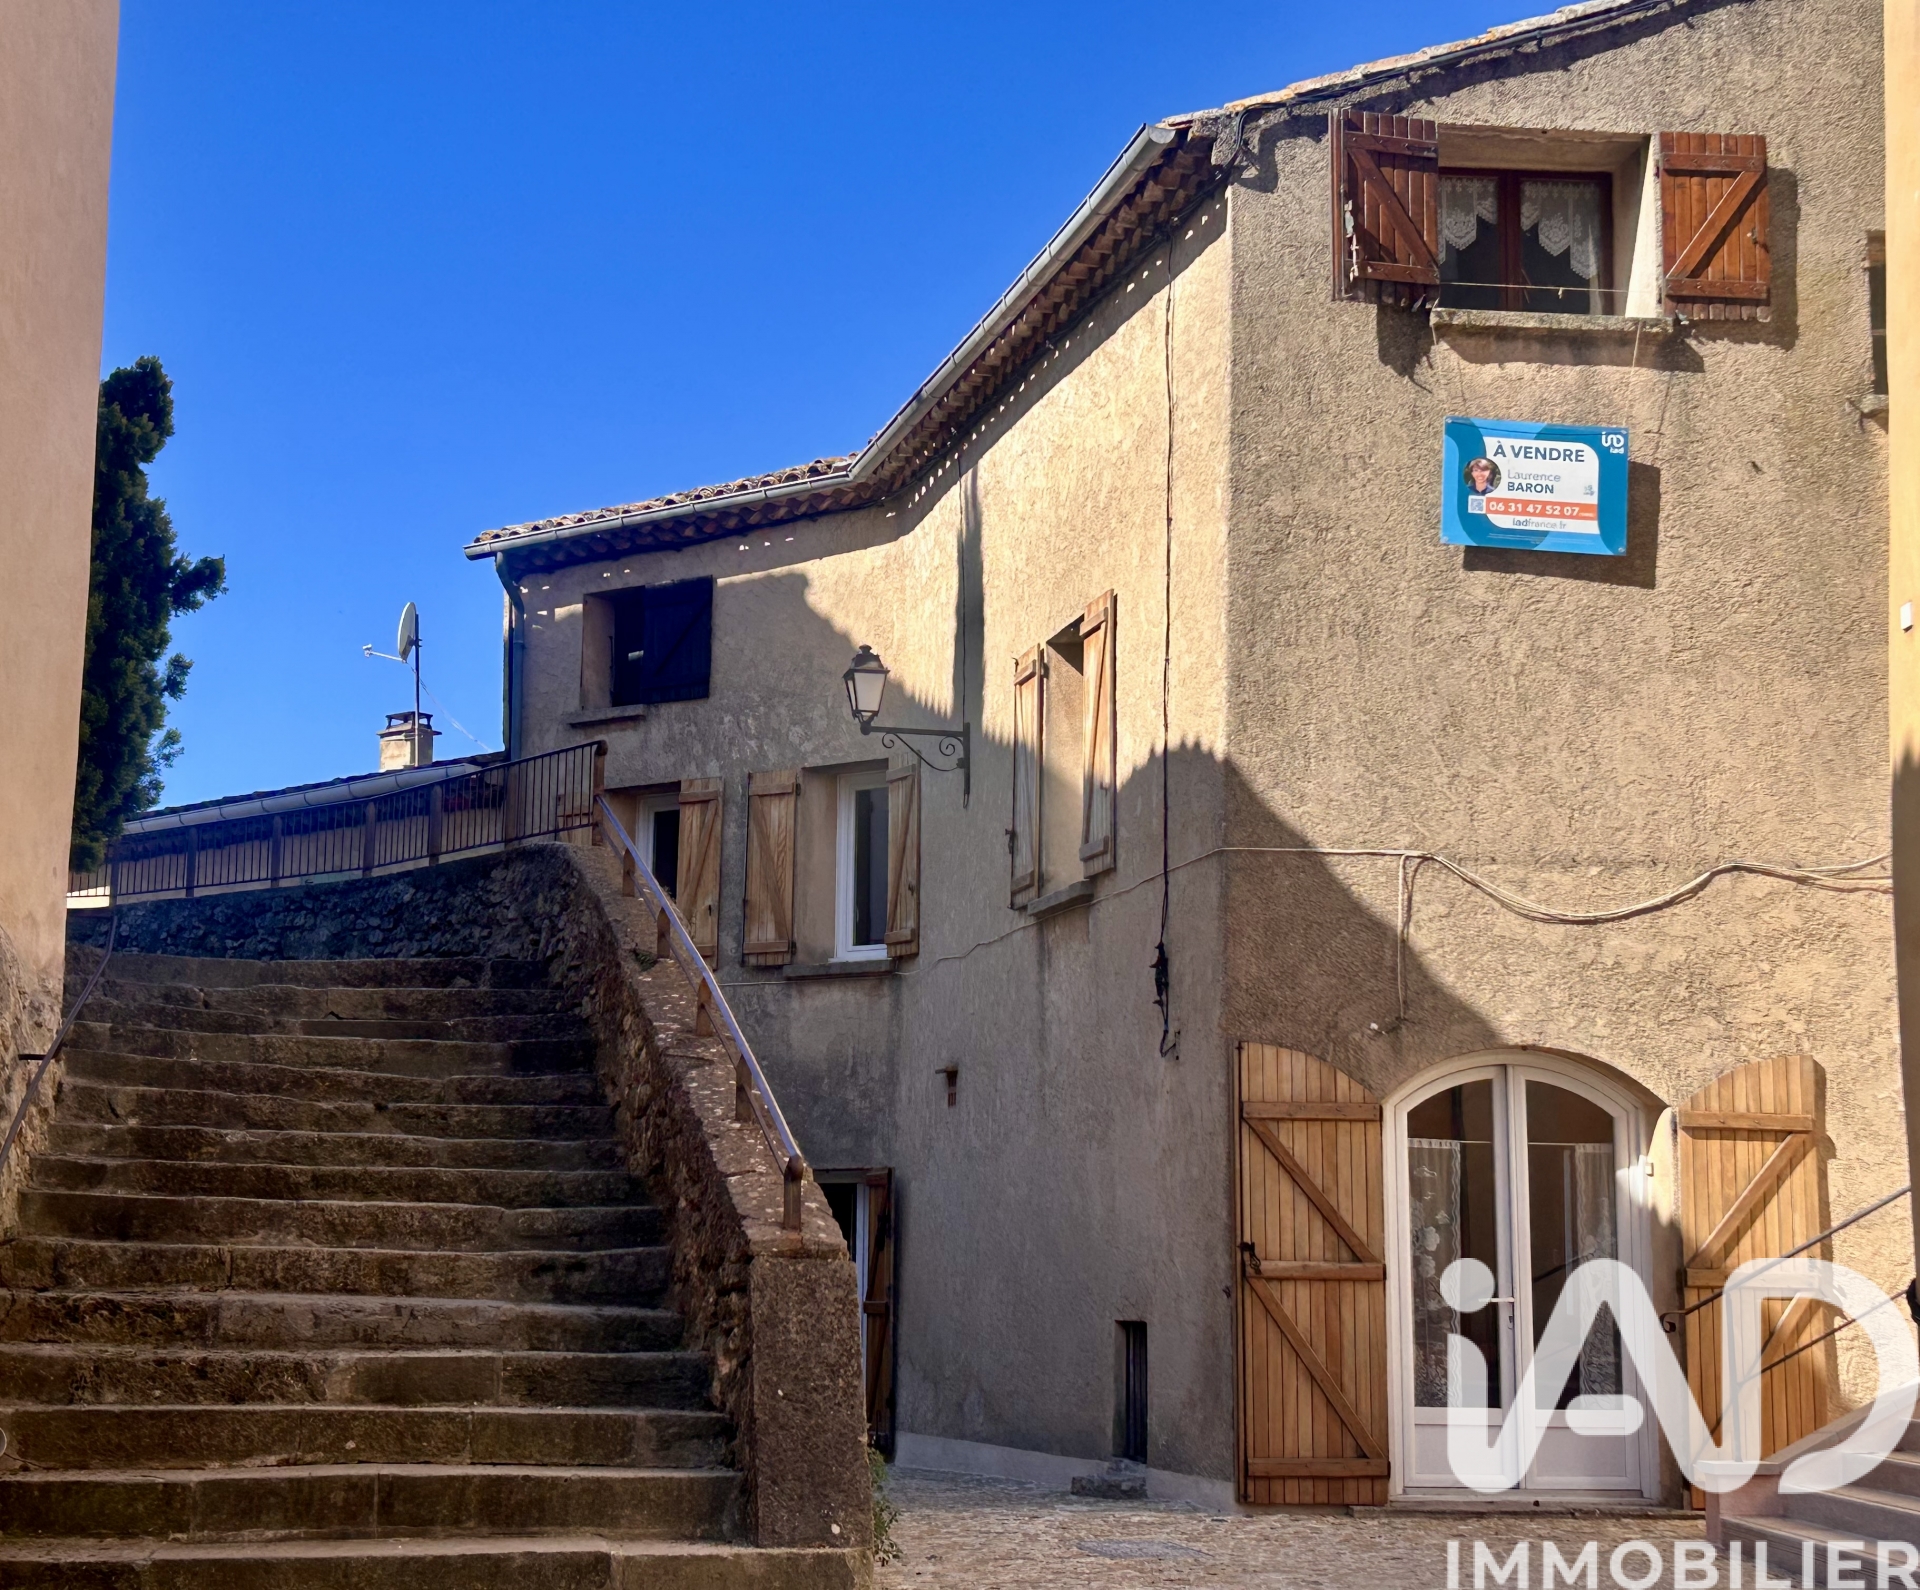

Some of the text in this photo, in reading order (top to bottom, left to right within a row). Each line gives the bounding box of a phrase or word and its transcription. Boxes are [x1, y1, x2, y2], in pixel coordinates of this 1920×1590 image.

[1493, 440, 1585, 463] À VENDRE
[1507, 469, 1561, 482] Laurence
[1507, 482, 1554, 494] BARON
[1489, 501, 1505, 511] 06
[1508, 502, 1522, 512] 31
[1526, 503, 1541, 514] 47
[1545, 505, 1561, 515] 52
[1563, 506, 1580, 516] 07
